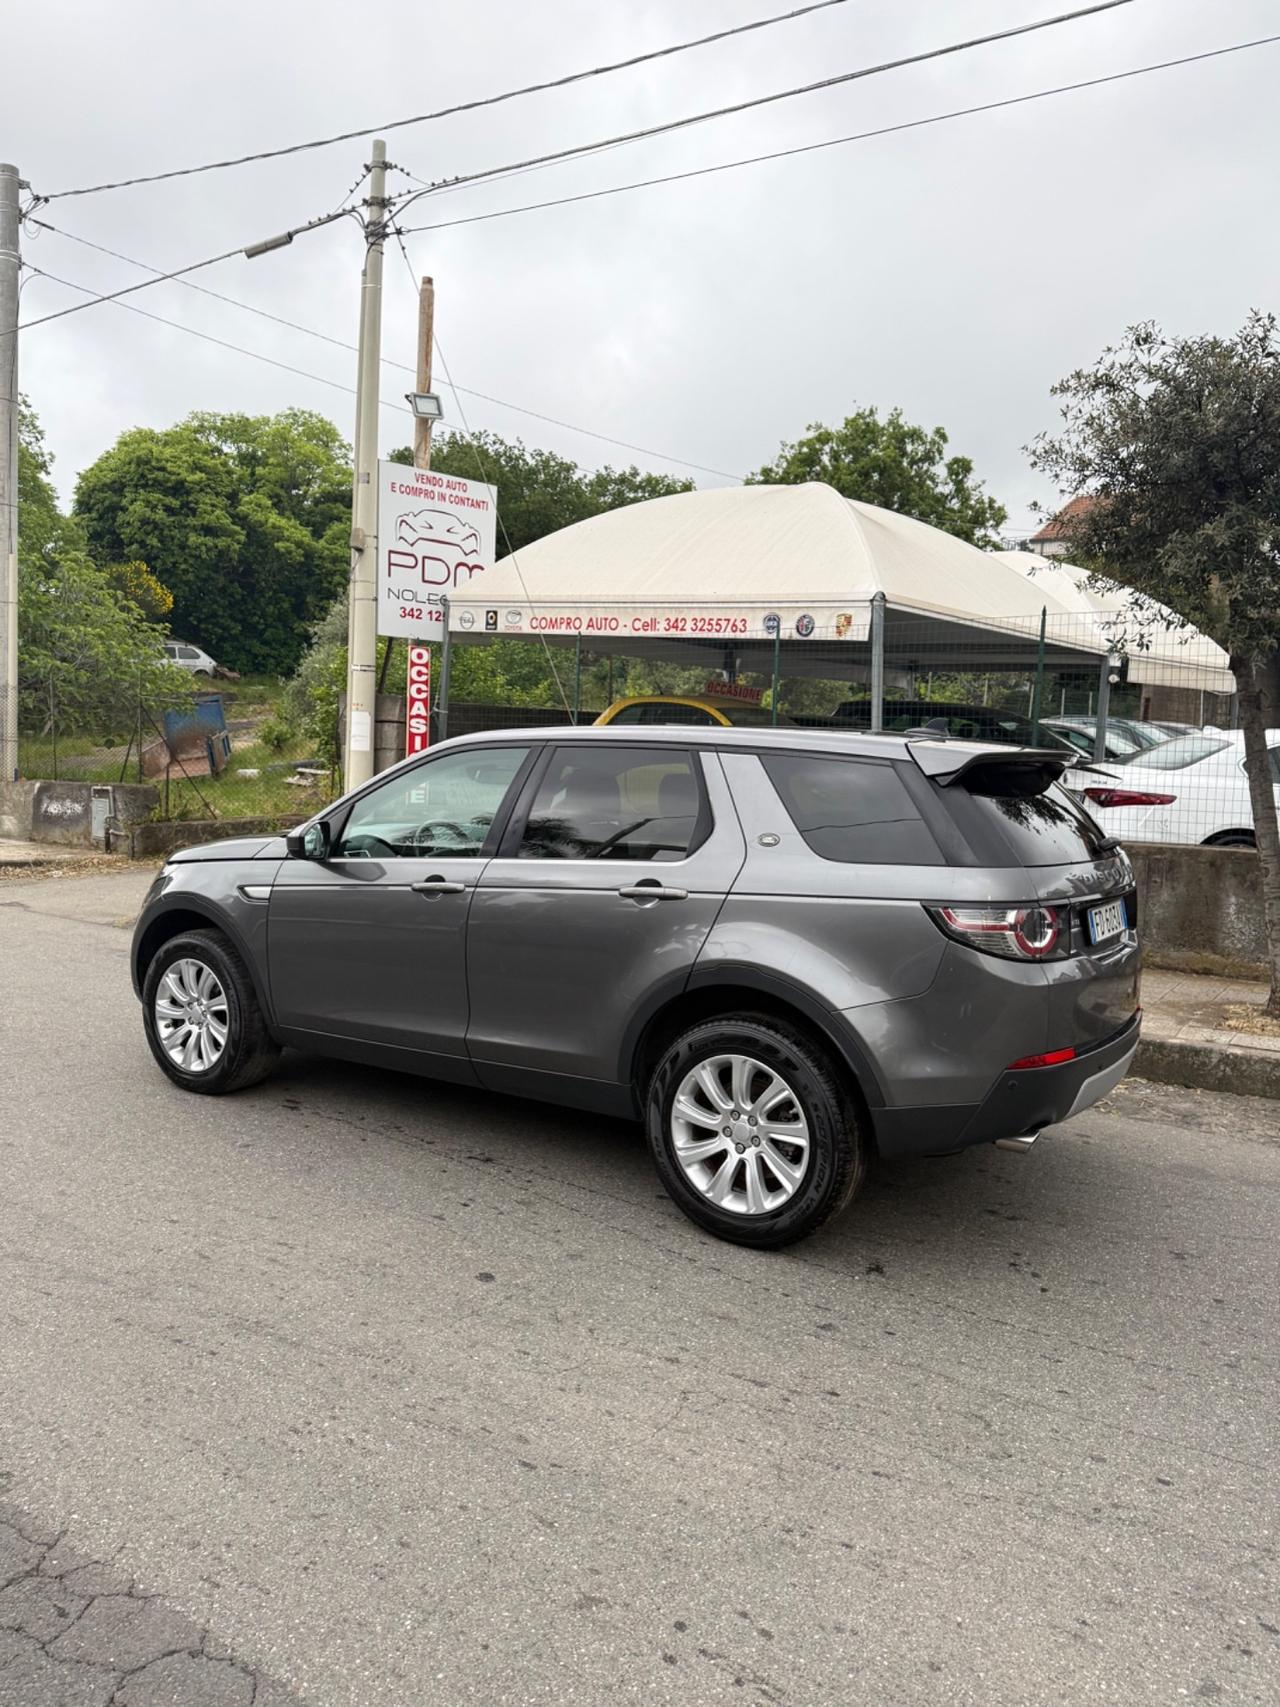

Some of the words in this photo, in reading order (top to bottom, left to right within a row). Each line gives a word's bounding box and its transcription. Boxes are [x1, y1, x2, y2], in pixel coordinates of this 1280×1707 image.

[414, 472, 443, 488] VENDO
[446, 479, 468, 493] AUTO
[390, 482, 397, 492] E
[399, 484, 435, 501] COMPRO
[437, 492, 446, 503] IN
[448, 494, 489, 512] CONTANTI
[399, 606, 423, 620] 342
[529, 616, 582, 631] COMPRO
[586, 617, 619, 631] AUTO
[631, 617, 660, 632] Cell:
[663, 617, 687, 632] 342
[690, 617, 747, 633] 3255763
